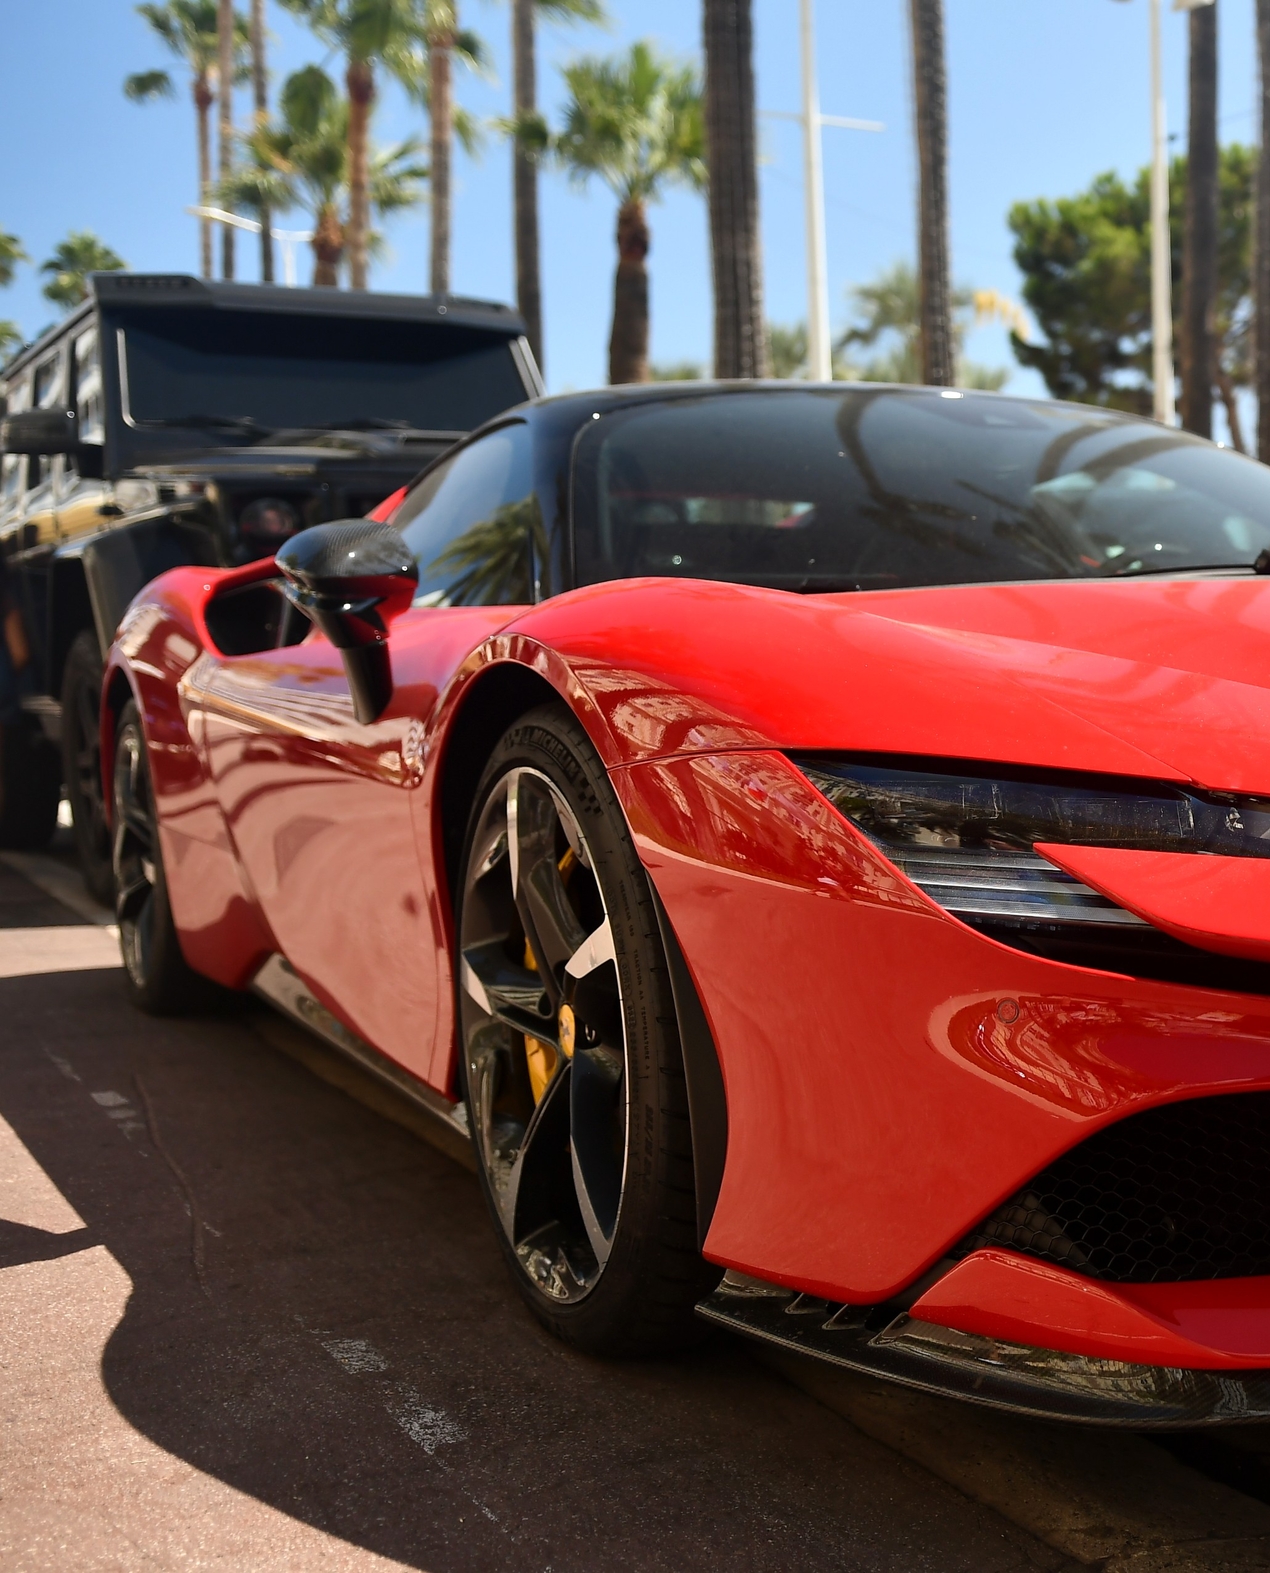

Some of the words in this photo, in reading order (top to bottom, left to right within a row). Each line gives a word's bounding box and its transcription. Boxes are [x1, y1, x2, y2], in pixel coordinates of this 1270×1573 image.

[531, 729, 580, 777] MICHELIN
[633, 948, 643, 986] TRACTION
[641, 1006, 651, 1060] TEMPERATURE
